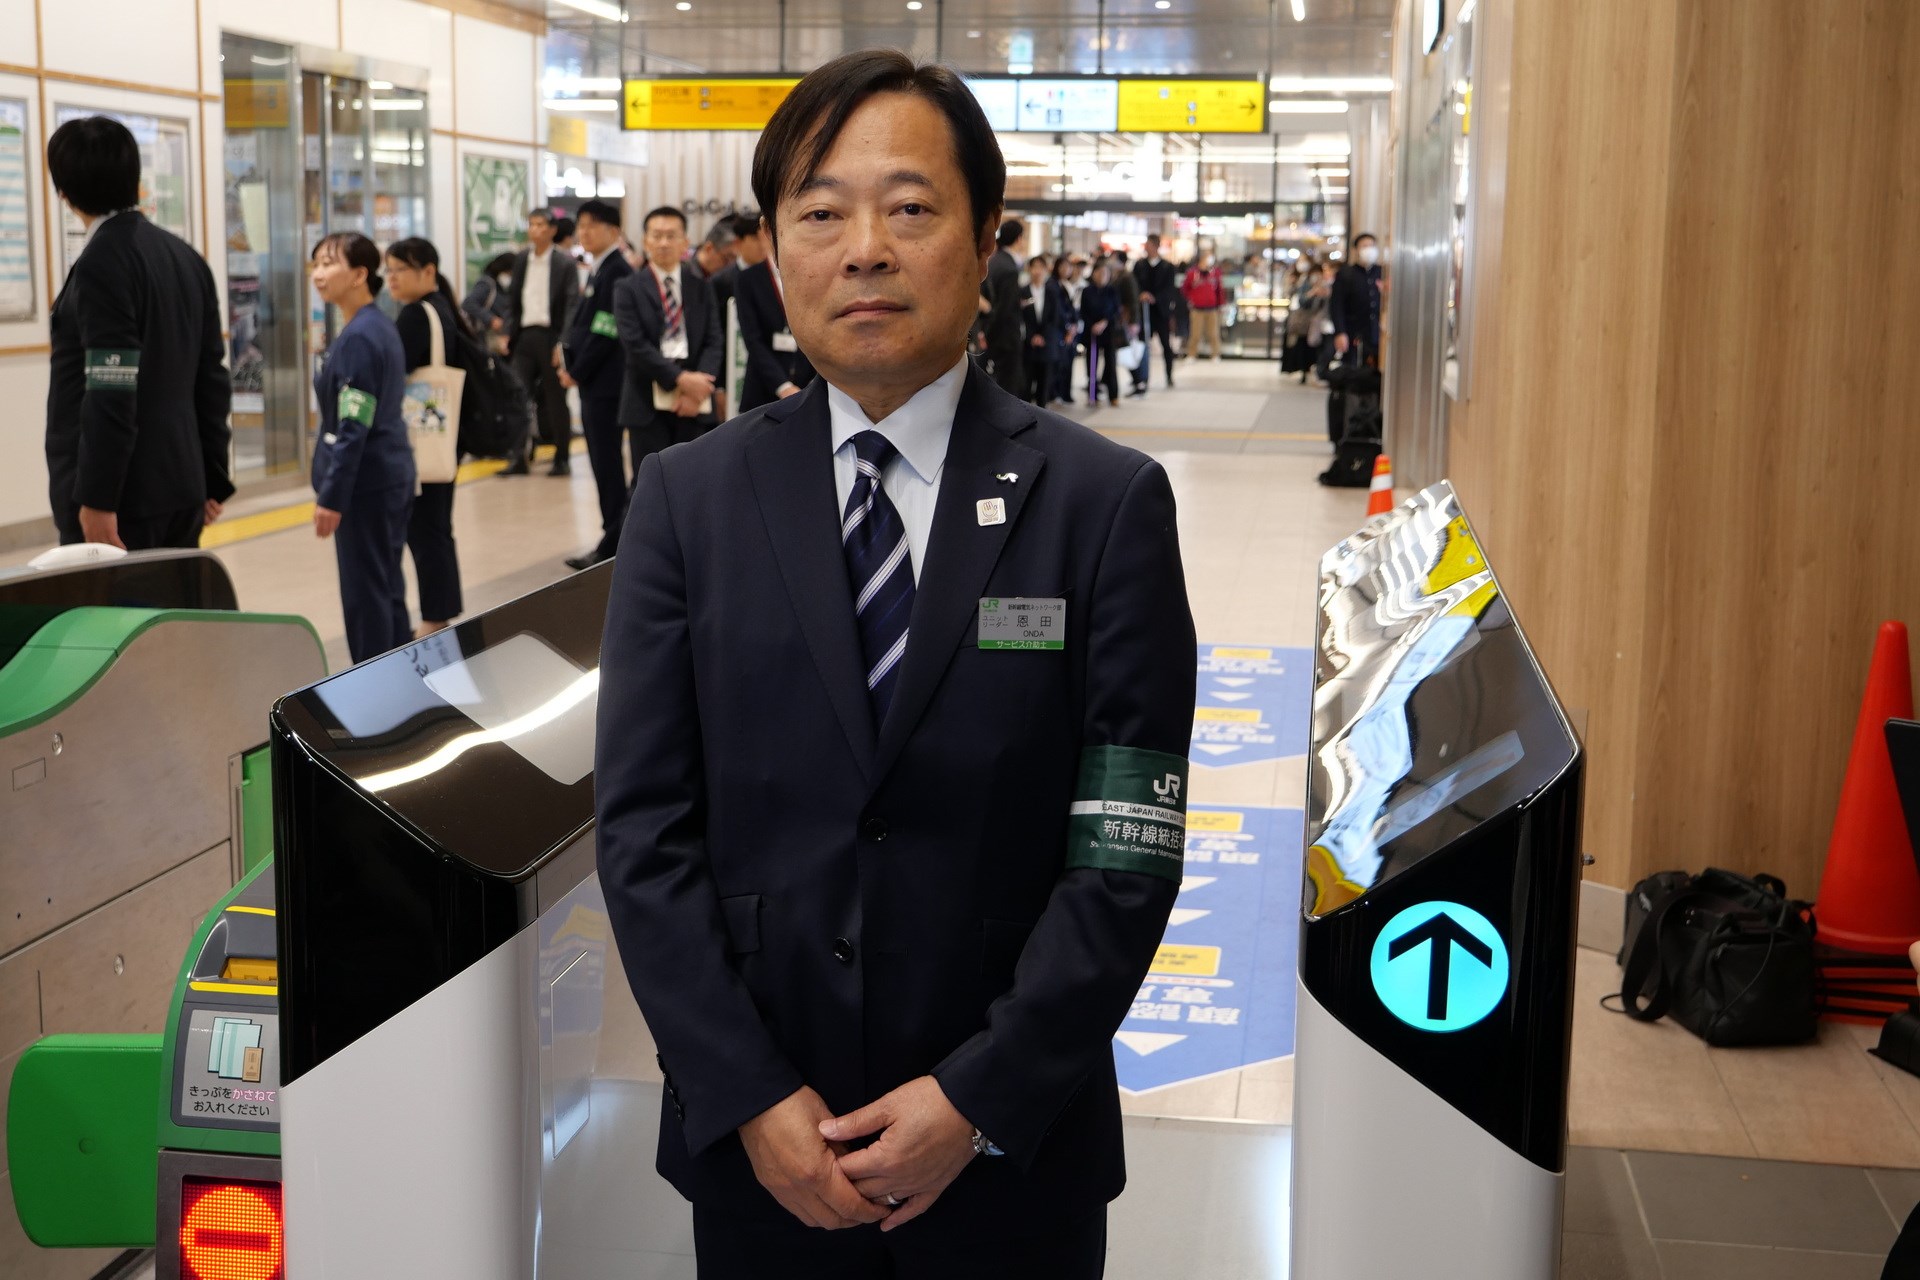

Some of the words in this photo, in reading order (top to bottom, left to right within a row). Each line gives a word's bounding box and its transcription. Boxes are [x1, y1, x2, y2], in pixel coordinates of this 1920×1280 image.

[982, 599, 999, 609] JR
[1022, 630, 1045, 638] ONDA
[996, 640, 1047, 649] サービス介助士
[1153, 773, 1181, 799] JR
[1102, 803, 1124, 812] EAST
[1126, 806, 1154, 817] JAPAN
[1155, 810, 1179, 821] RAILWAY
[1130, 844, 1157, 855] General
[189, 1085, 276, 1102] きっぷをかさねて
[193, 1101, 270, 1116] お入れください
